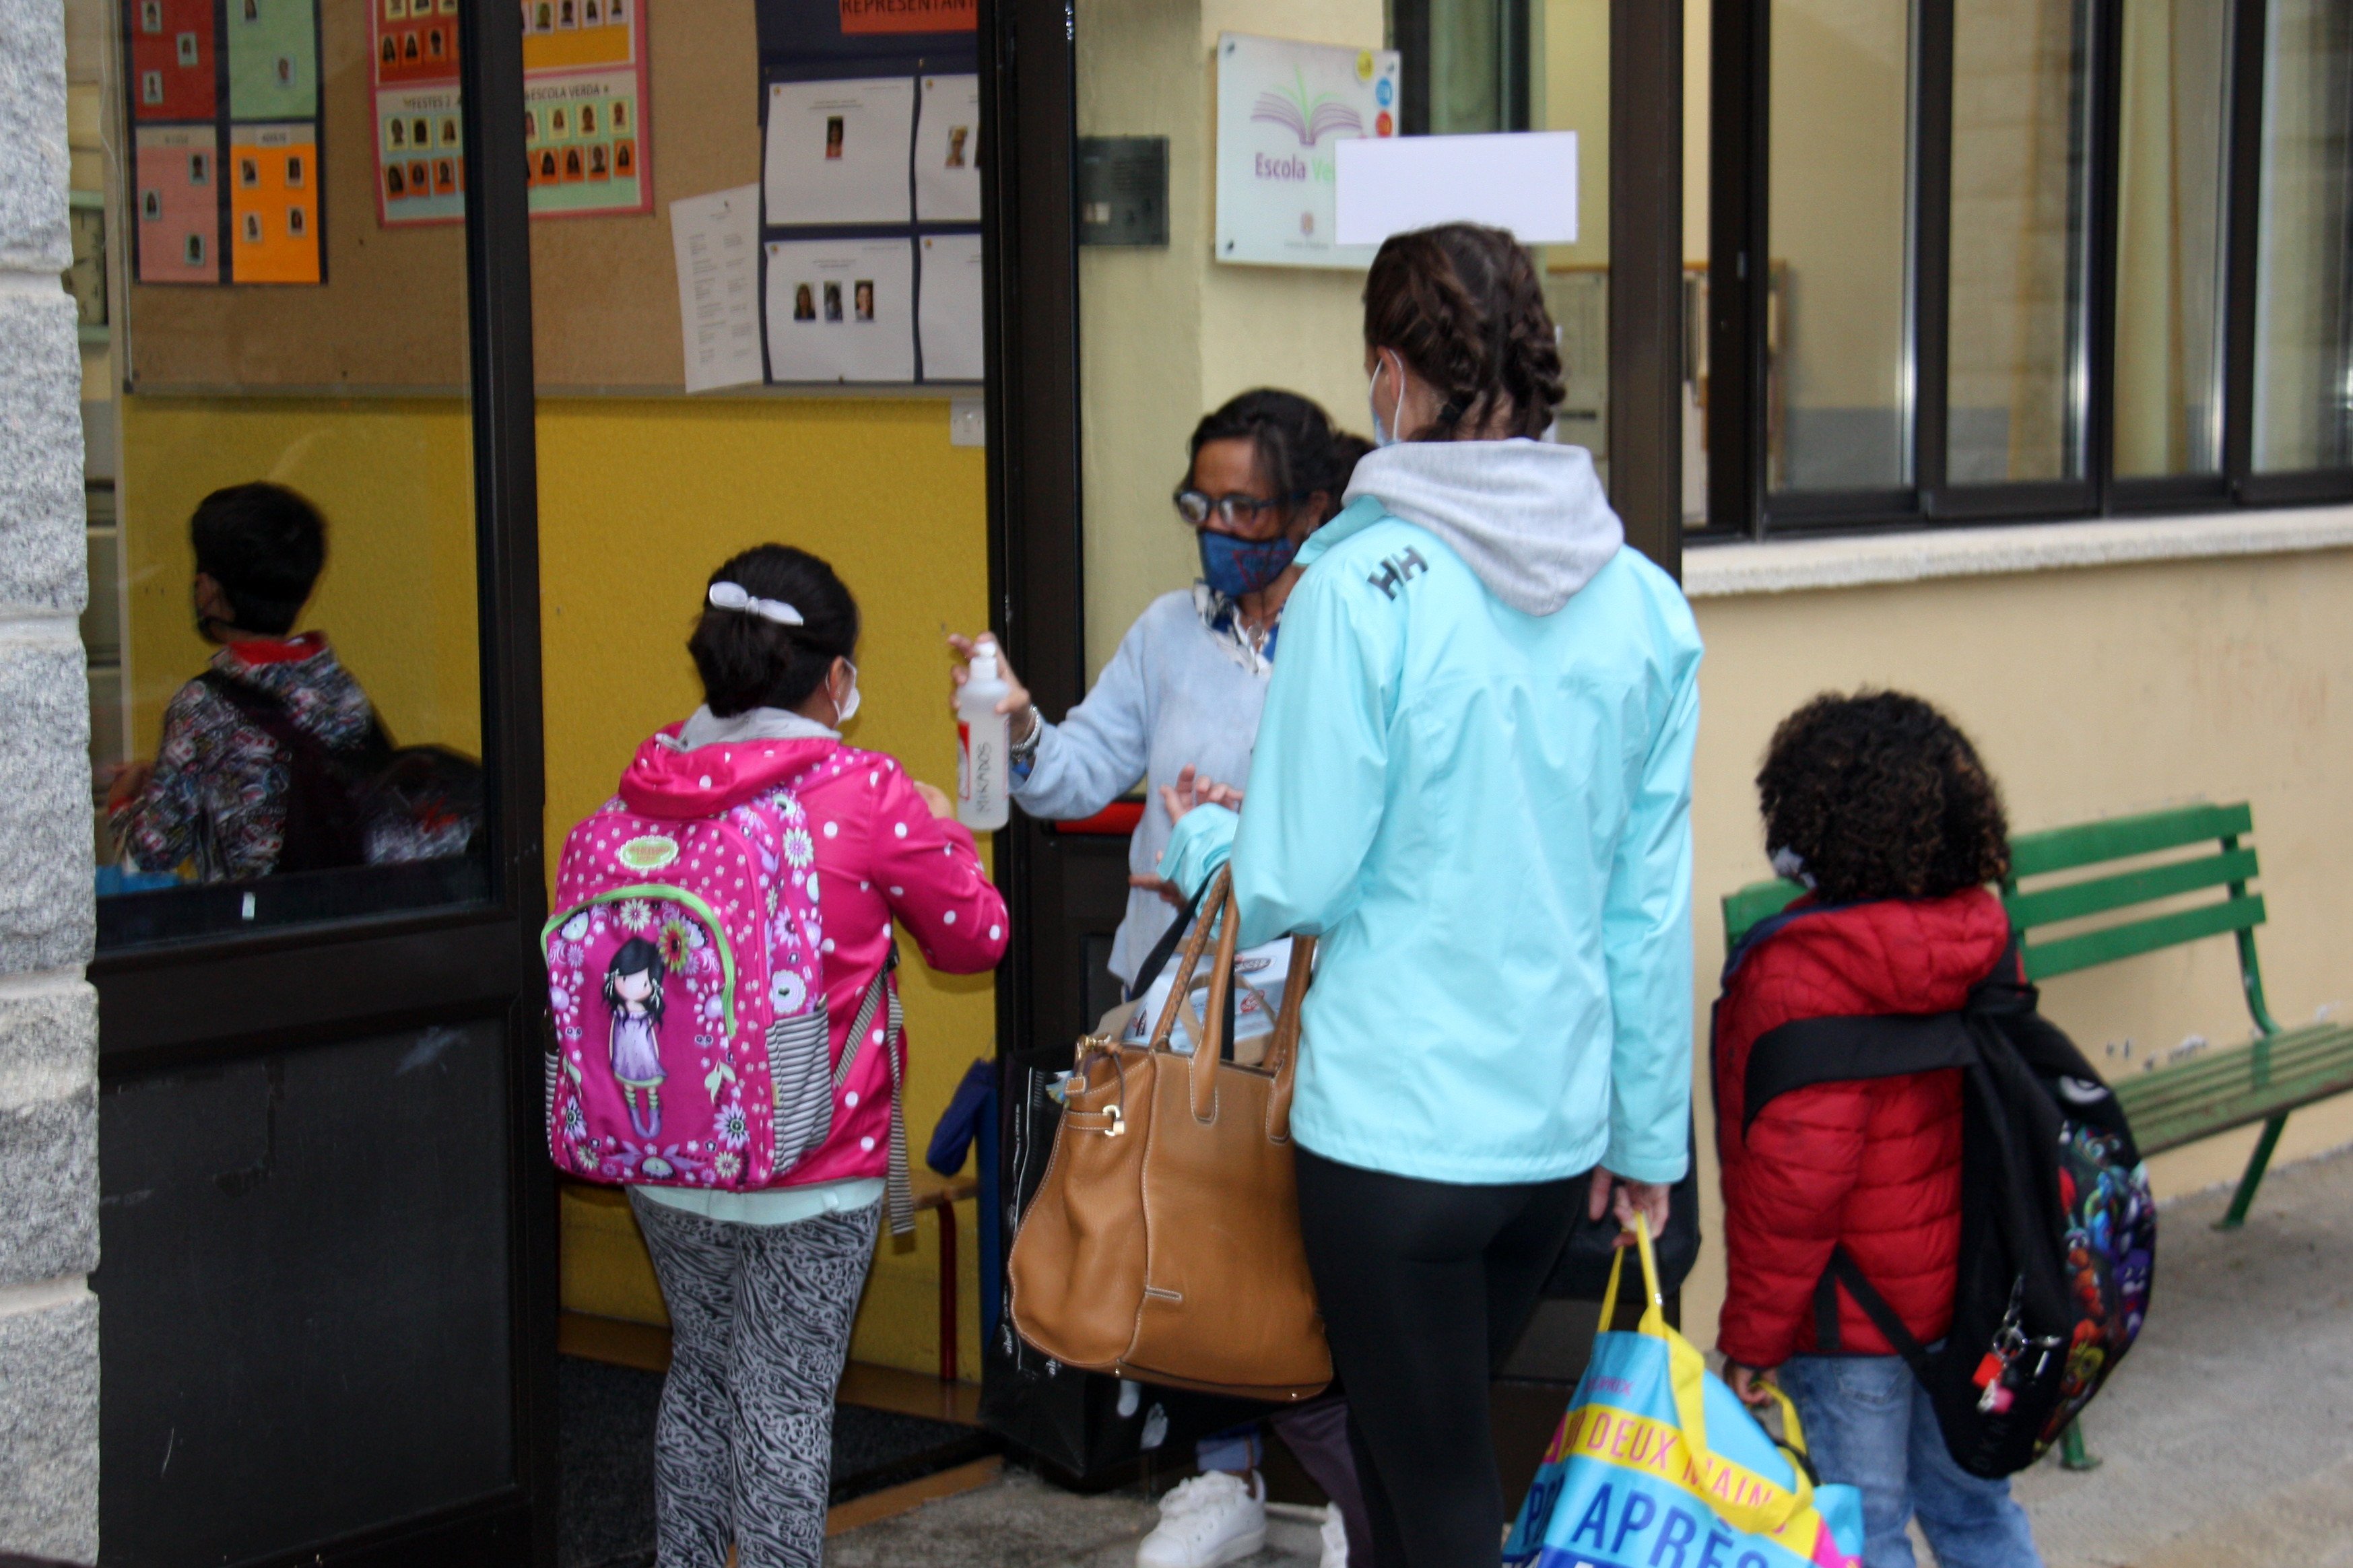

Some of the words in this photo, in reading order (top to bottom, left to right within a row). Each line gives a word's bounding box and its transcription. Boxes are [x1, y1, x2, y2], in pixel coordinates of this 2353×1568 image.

[531, 86, 566, 100] ESCOLA
[568, 81, 599, 96] VERDA
[1255, 152, 1306, 182] Escola
[1587, 1411, 1678, 1470] DEUX
